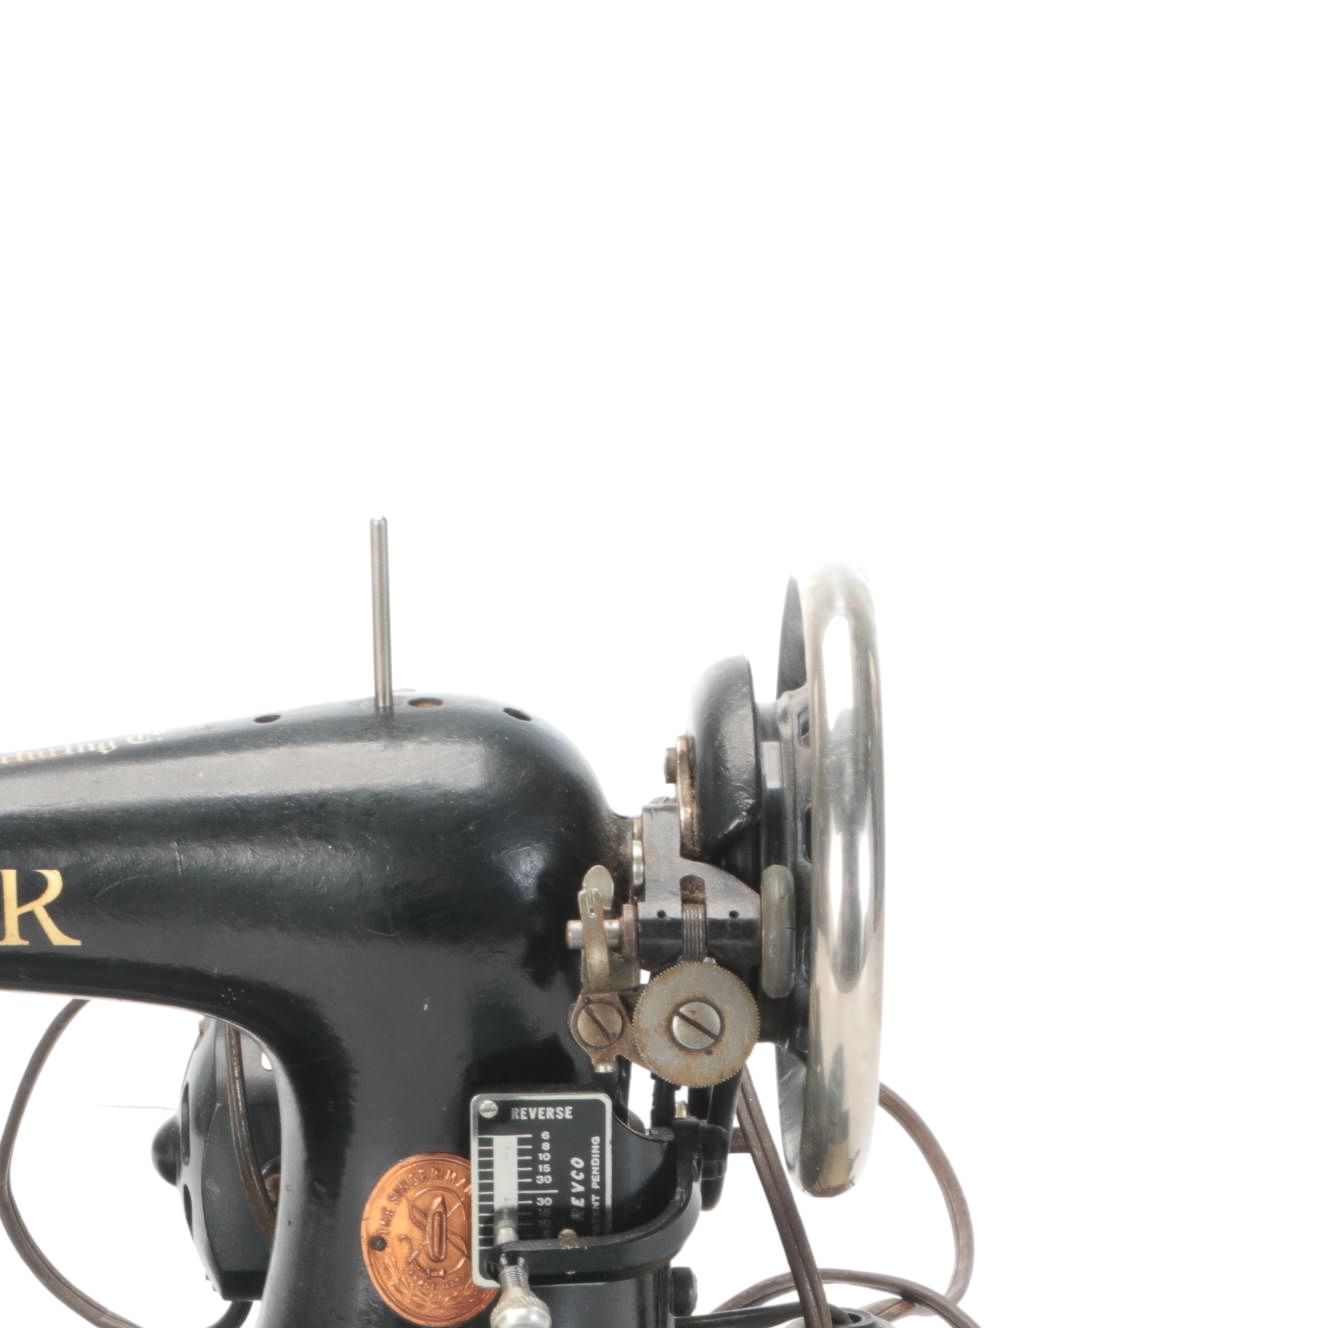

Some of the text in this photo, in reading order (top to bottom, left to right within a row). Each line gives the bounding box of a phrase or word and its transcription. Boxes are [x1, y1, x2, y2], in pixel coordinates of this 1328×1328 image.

[510, 1106, 574, 1120] REVERSE
[540, 1131, 551, 1140] 6
[541, 1142, 551, 1151] 8
[538, 1153, 552, 1162] 10
[590, 1136, 601, 1189] PENDING
[538, 1164, 552, 1173] 15
[536, 1175, 553, 1185] 30
[536, 1197, 553, 1207] 30
